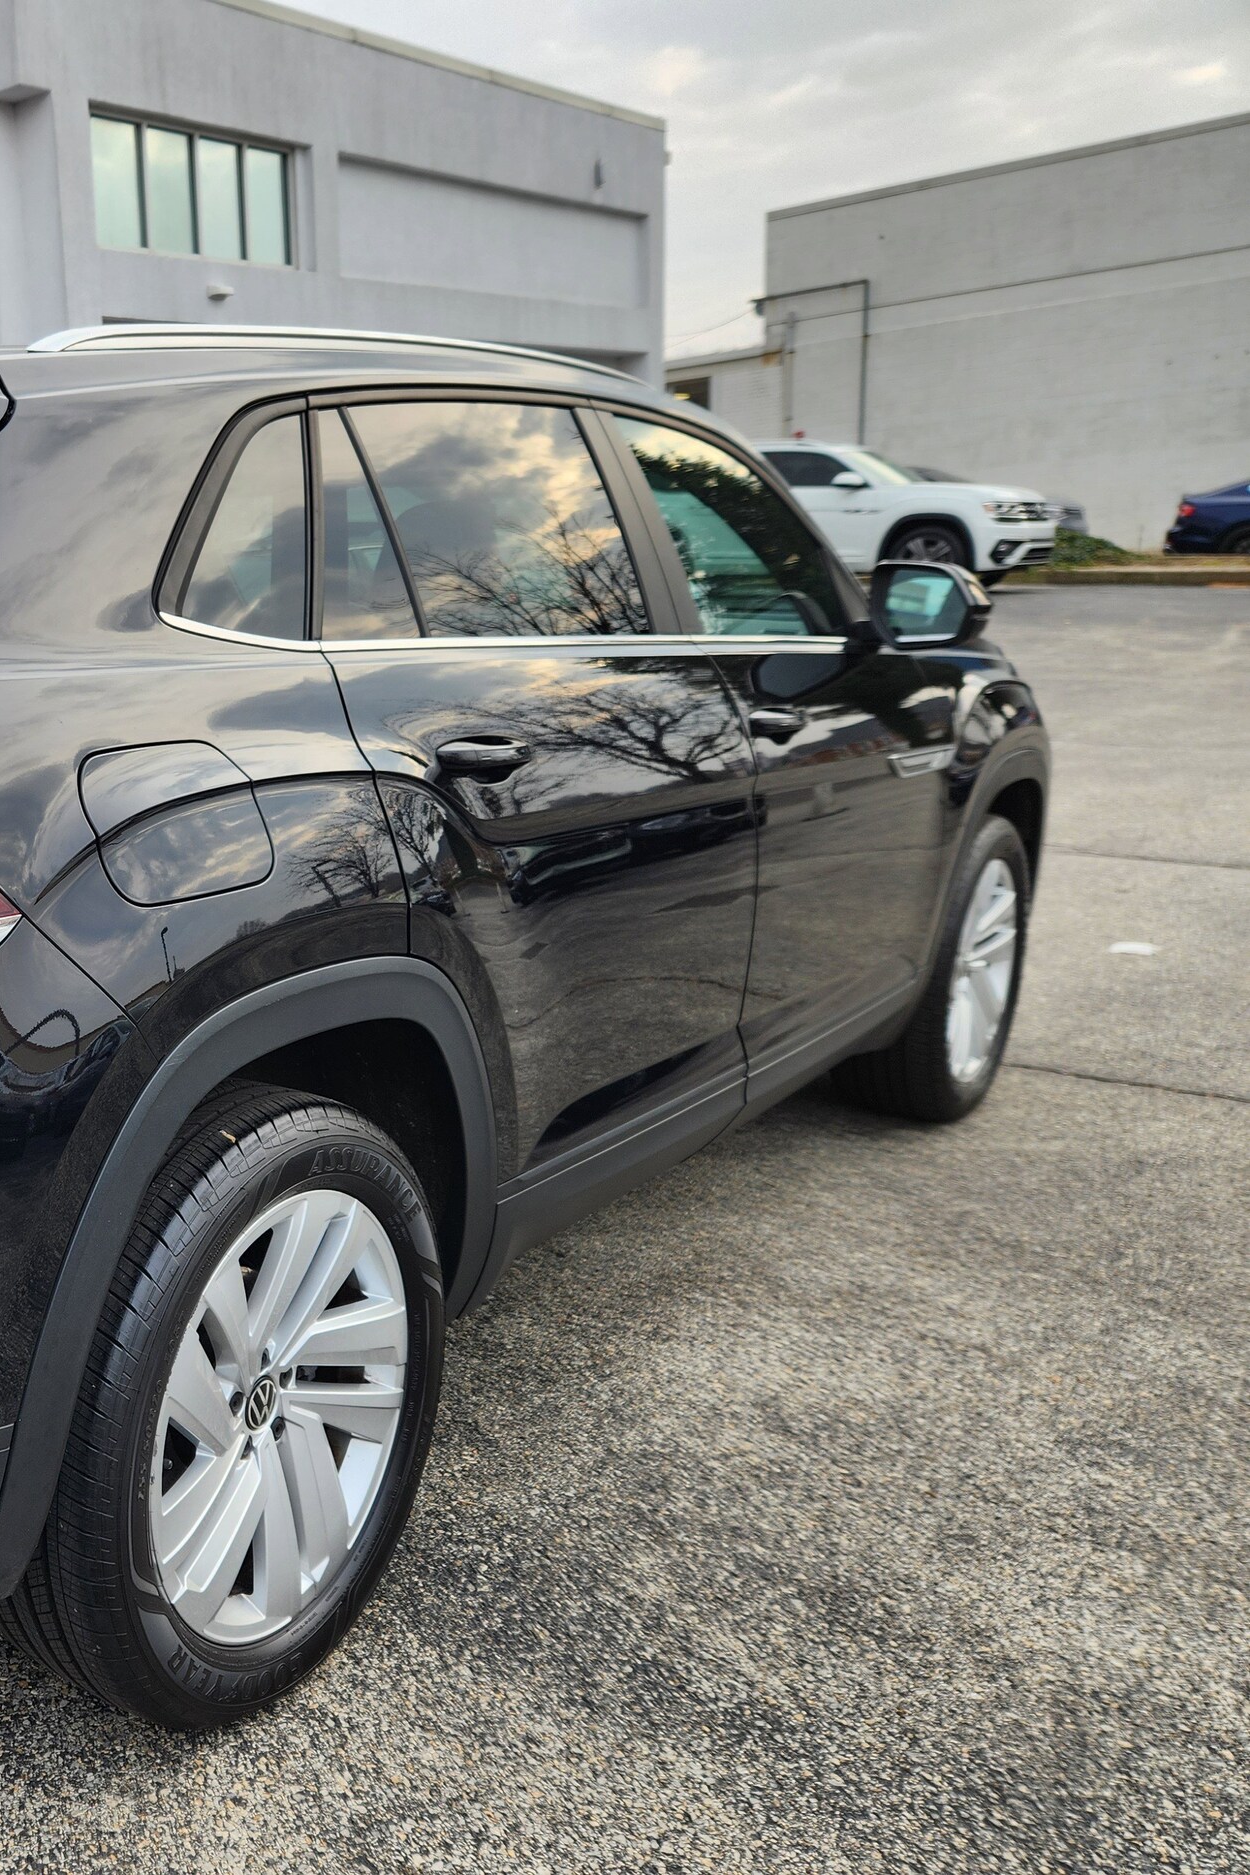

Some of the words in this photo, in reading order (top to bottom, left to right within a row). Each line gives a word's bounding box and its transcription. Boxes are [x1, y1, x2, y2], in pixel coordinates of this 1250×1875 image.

[307, 1146, 424, 1222] ASSURANCE
[247, 1378, 276, 1430] VW
[166, 1643, 305, 1702] GOODYEAR
